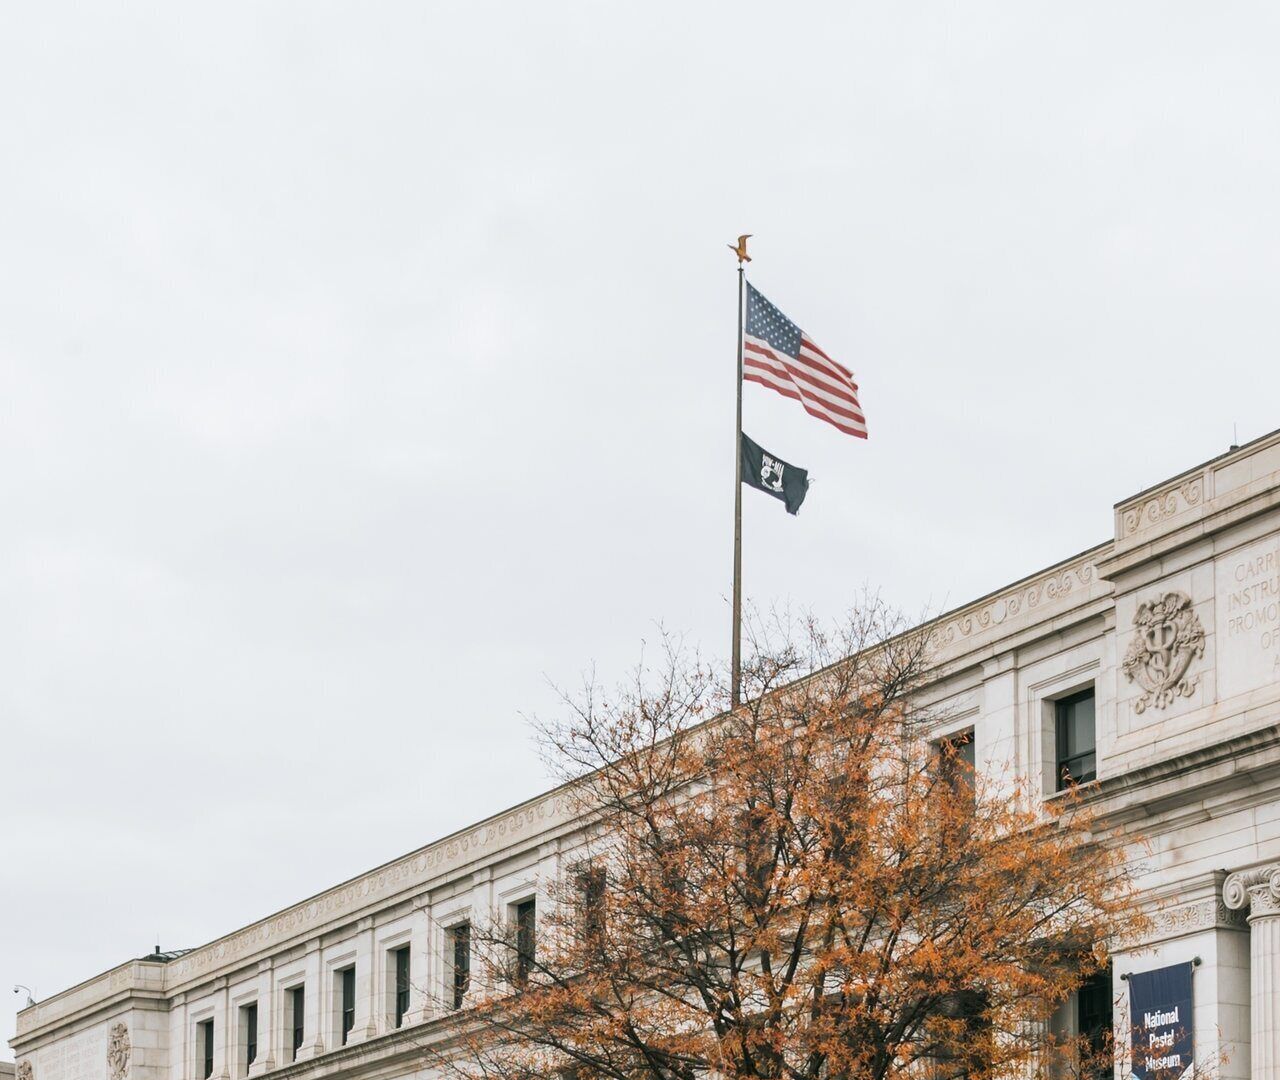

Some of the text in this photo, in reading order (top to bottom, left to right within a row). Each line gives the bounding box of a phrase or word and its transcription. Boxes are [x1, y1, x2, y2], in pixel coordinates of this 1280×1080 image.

[1260, 627, 1280, 650] OF
[1144, 1006, 1180, 1029] National
[1149, 1029, 1175, 1049] Postal
[1145, 1054, 1181, 1072] Museum
